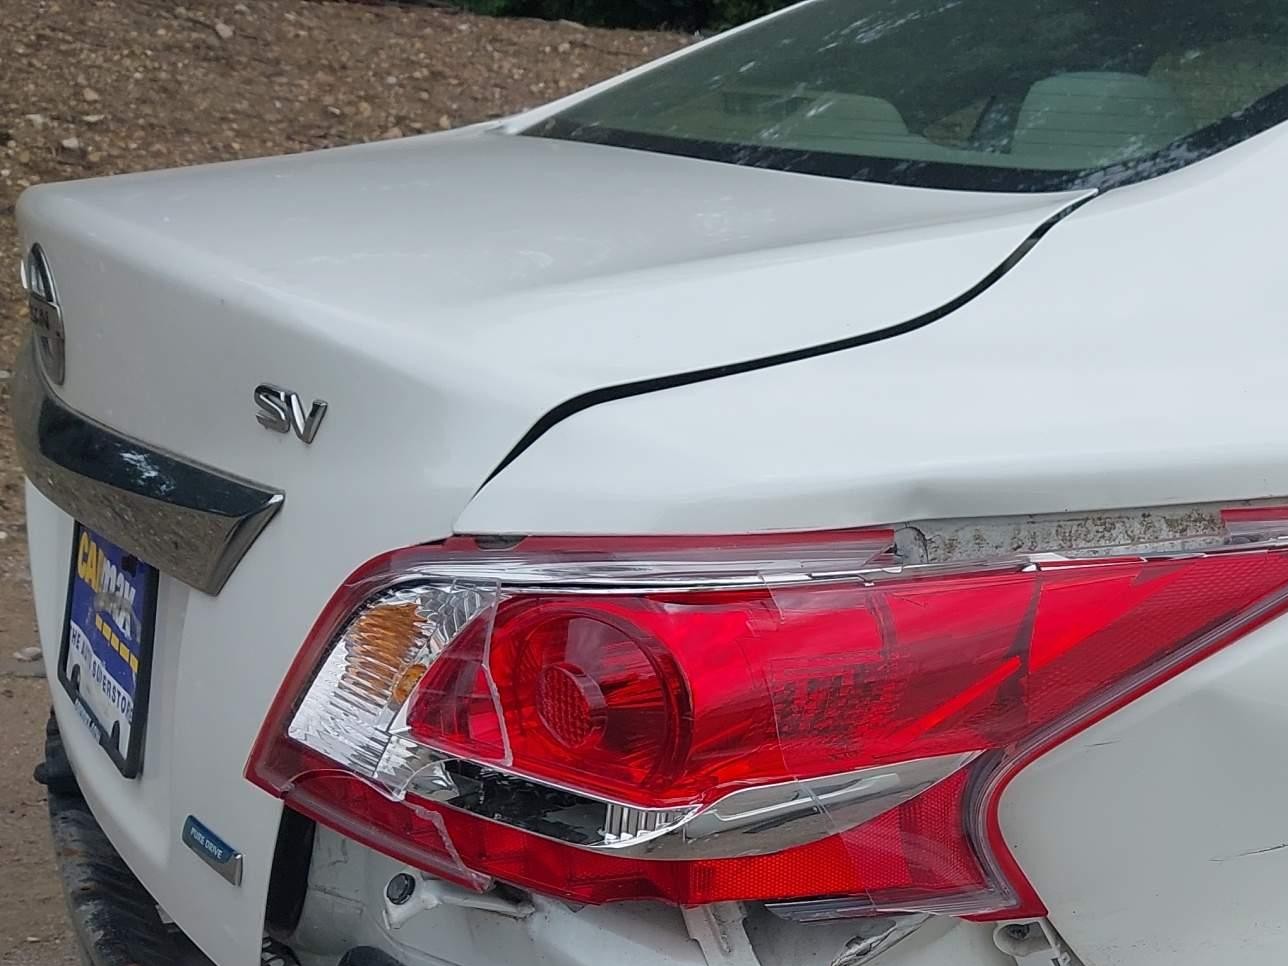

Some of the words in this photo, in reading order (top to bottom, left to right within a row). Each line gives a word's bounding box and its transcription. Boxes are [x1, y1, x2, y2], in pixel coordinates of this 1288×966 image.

[254, 384, 328, 445] SV
[189, 826, 206, 846] PURE
[204, 841, 223, 860] DRIVE
